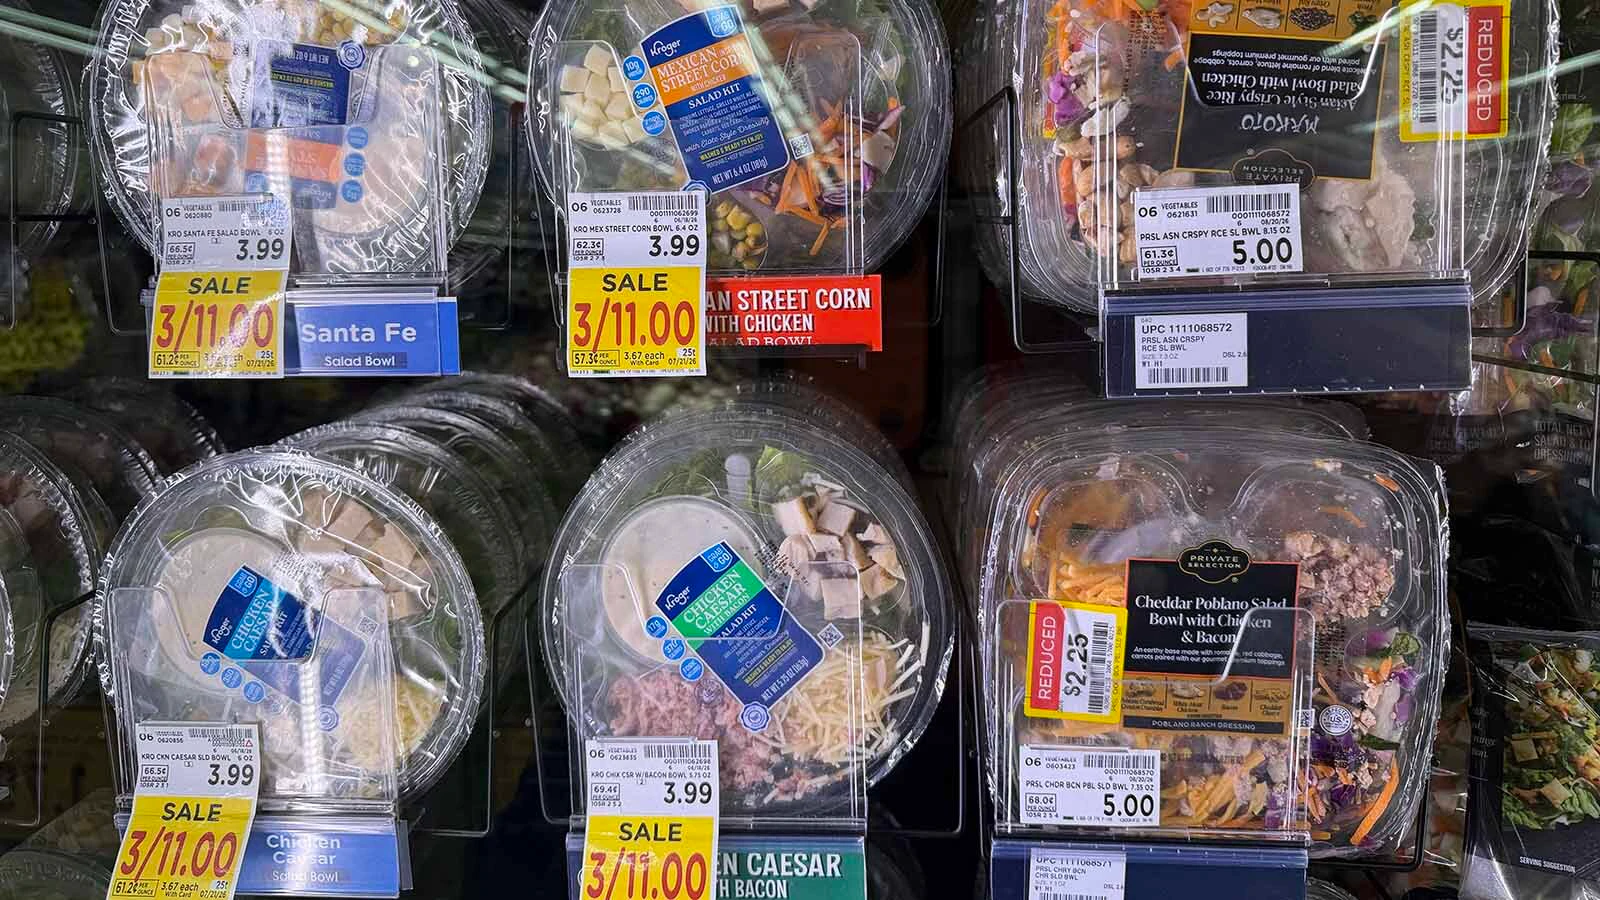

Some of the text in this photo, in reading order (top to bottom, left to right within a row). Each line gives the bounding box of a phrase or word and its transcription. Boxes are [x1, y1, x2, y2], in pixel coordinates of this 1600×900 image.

[650, 39, 681, 57] Kroger
[657, 46, 719, 79] MEXICAN
[1477, 19, 1493, 121] REDUCED
[660, 66, 711, 93] STREET
[1202, 72, 1257, 87] Chicken
[1259, 75, 1288, 89] with
[1292, 77, 1326, 92] Bowl
[634, 87, 650, 99] 290
[688, 82, 741, 110] SALAD KIT
[1206, 90, 1236, 104] Rice
[1238, 92, 1280, 109] Crispy
[1241, 112, 1319, 134] MAKOTO
[1243, 165, 1305, 175] SELECTION
[1247, 172, 1300, 182] PRIVATE
[166, 208, 181, 217] 06
[571, 202, 588, 212] 06
[1138, 201, 1198, 217] 06 VEGETABLES
[1167, 210, 1198, 219] 0621631
[1231, 210, 1290, 220] 0001111068572
[183, 229, 260, 238] SANTA SALAD BOWL
[1139, 226, 1291, 241] PRSL ASN CRSPY RCE SL BWL 8.15 OZ
[236, 238, 284, 260] 3.99
[576, 241, 601, 249] 62.3¢
[649, 234, 699, 256] 3.99
[1232, 237, 1293, 265] 5.00
[1144, 249, 1174, 259] 61.3¢
[188, 277, 252, 294] SALE
[602, 273, 668, 292] SALE
[737, 287, 871, 311] STREET CORN
[156, 300, 274, 355] 3/11.00
[573, 298, 695, 352] 3/11.00
[744, 313, 813, 333] CHICKEN
[1142, 322, 1232, 335] UPC 1111068572
[302, 322, 417, 343] Santa Fe
[1180, 335, 1205, 343] CRSPY
[624, 352, 665, 360] 3.67 each
[1142, 344, 1157, 352] RCE
[1170, 343, 1187, 351] BWL
[325, 354, 395, 368] Salad Bowl
[718, 552, 729, 565] GO
[1190, 555, 1239, 563] PRIVATE
[665, 586, 691, 610] Kroger
[683, 568, 742, 623] CHICKEN
[1135, 595, 1287, 612] Cheddar Poblano Salad
[695, 583, 747, 630] CAESAR
[743, 604, 758, 621] KIT
[231, 588, 272, 650] CHICKEN
[703, 614, 724, 636] WITH
[1149, 612, 1183, 626] Bowl
[1187, 614, 1215, 627] with
[210, 617, 232, 645] Kroger
[1180, 630, 1236, 644] & Bacon
[1038, 616, 1056, 700] REDUCED
[1131, 652, 1154, 660] carrots
[1173, 654, 1189, 662] with
[1164, 647, 1180, 655] base
[1181, 648, 1199, 656] made
[1062, 633, 1089, 696] $2.25
[1152, 720, 1256, 731] POBLANO RANCH DRESSING
[171, 753, 196, 761] CAESAR
[589, 749, 605, 758] 06
[1025, 757, 1042, 767] 06
[208, 763, 254, 785] 3.99
[664, 782, 712, 804] 3.99
[1025, 780, 1128, 791] PRSL BCN PBL SLD BWL
[1028, 796, 1054, 804] 68.0¢
[1103, 793, 1154, 817] 5.00
[161, 802, 222, 822] SALE
[619, 822, 682, 842] SALE
[266, 834, 341, 849] Chiken
[120, 826, 238, 883] 3/11.00
[747, 852, 841, 877] CAESAR
[1519, 856, 1576, 873] SERVING SUGGESTION
[310, 871, 339, 882] Bowl
[587, 847, 707, 900] 3/11.00
[161, 882, 199, 890] 3.67 each
[735, 879, 787, 899] BACON
